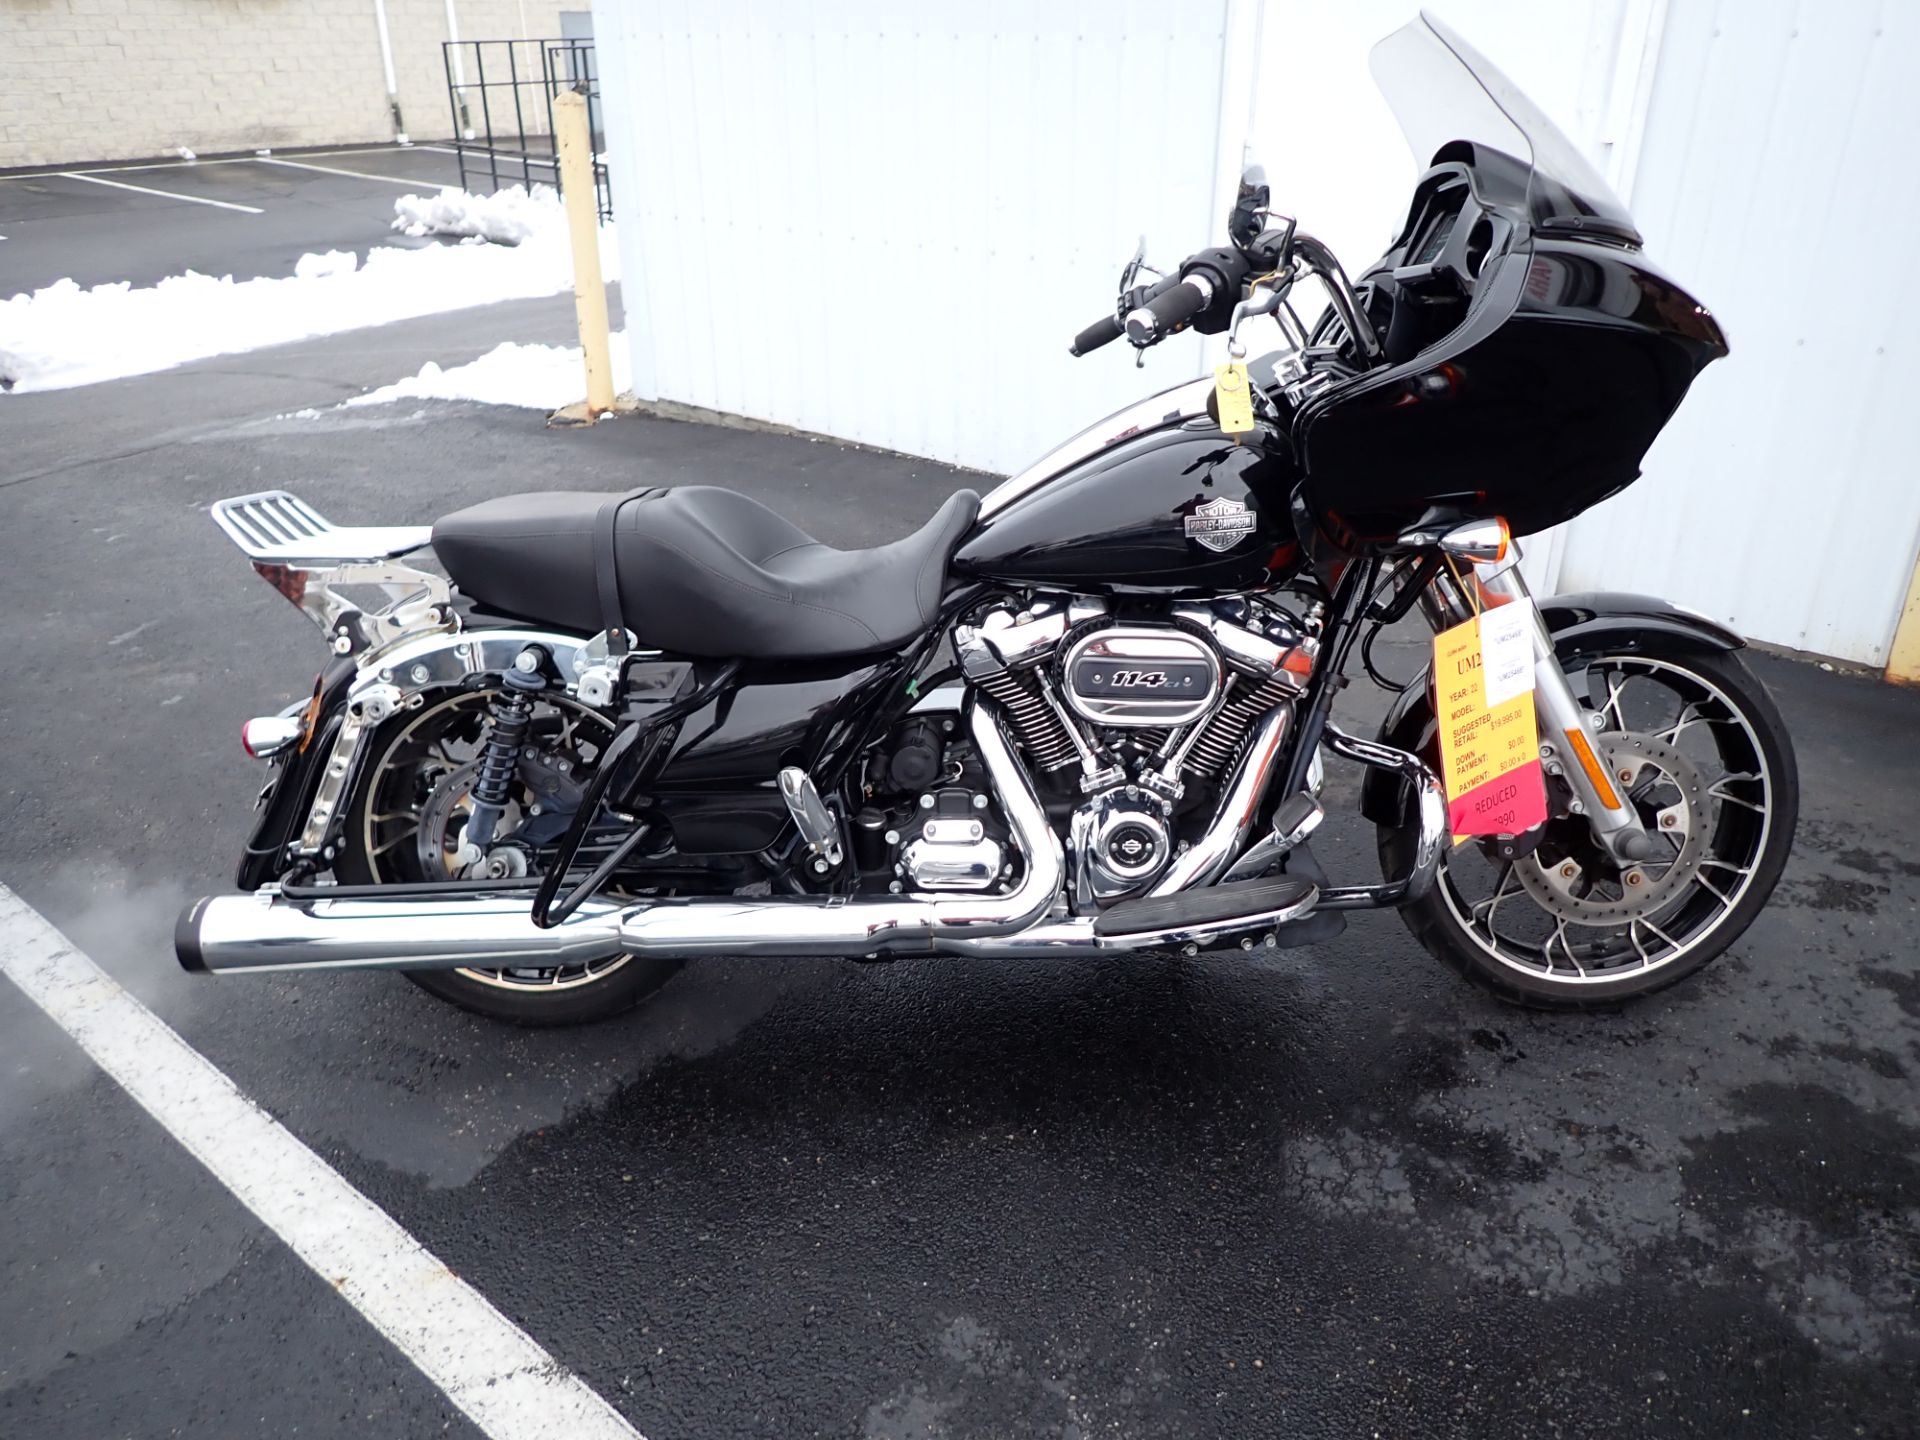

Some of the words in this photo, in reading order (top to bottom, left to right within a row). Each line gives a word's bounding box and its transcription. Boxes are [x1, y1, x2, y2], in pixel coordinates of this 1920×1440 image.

[1191, 516, 1251, 531] HARLEY-DAVIDSON
[1111, 671, 1167, 688] 114
[1449, 688, 1468, 703] YEAR:
[1451, 704, 1475, 720] MODEL:
[1453, 713, 1491, 738] SUGGESTED
[1454, 731, 1478, 748] RETAIL:
[1455, 750, 1475, 766] DOWN
[1456, 753, 1488, 775] PAYMENT:
[1458, 770, 1489, 793] PAYMENT:
[1475, 784, 1517, 814] REDUCED
